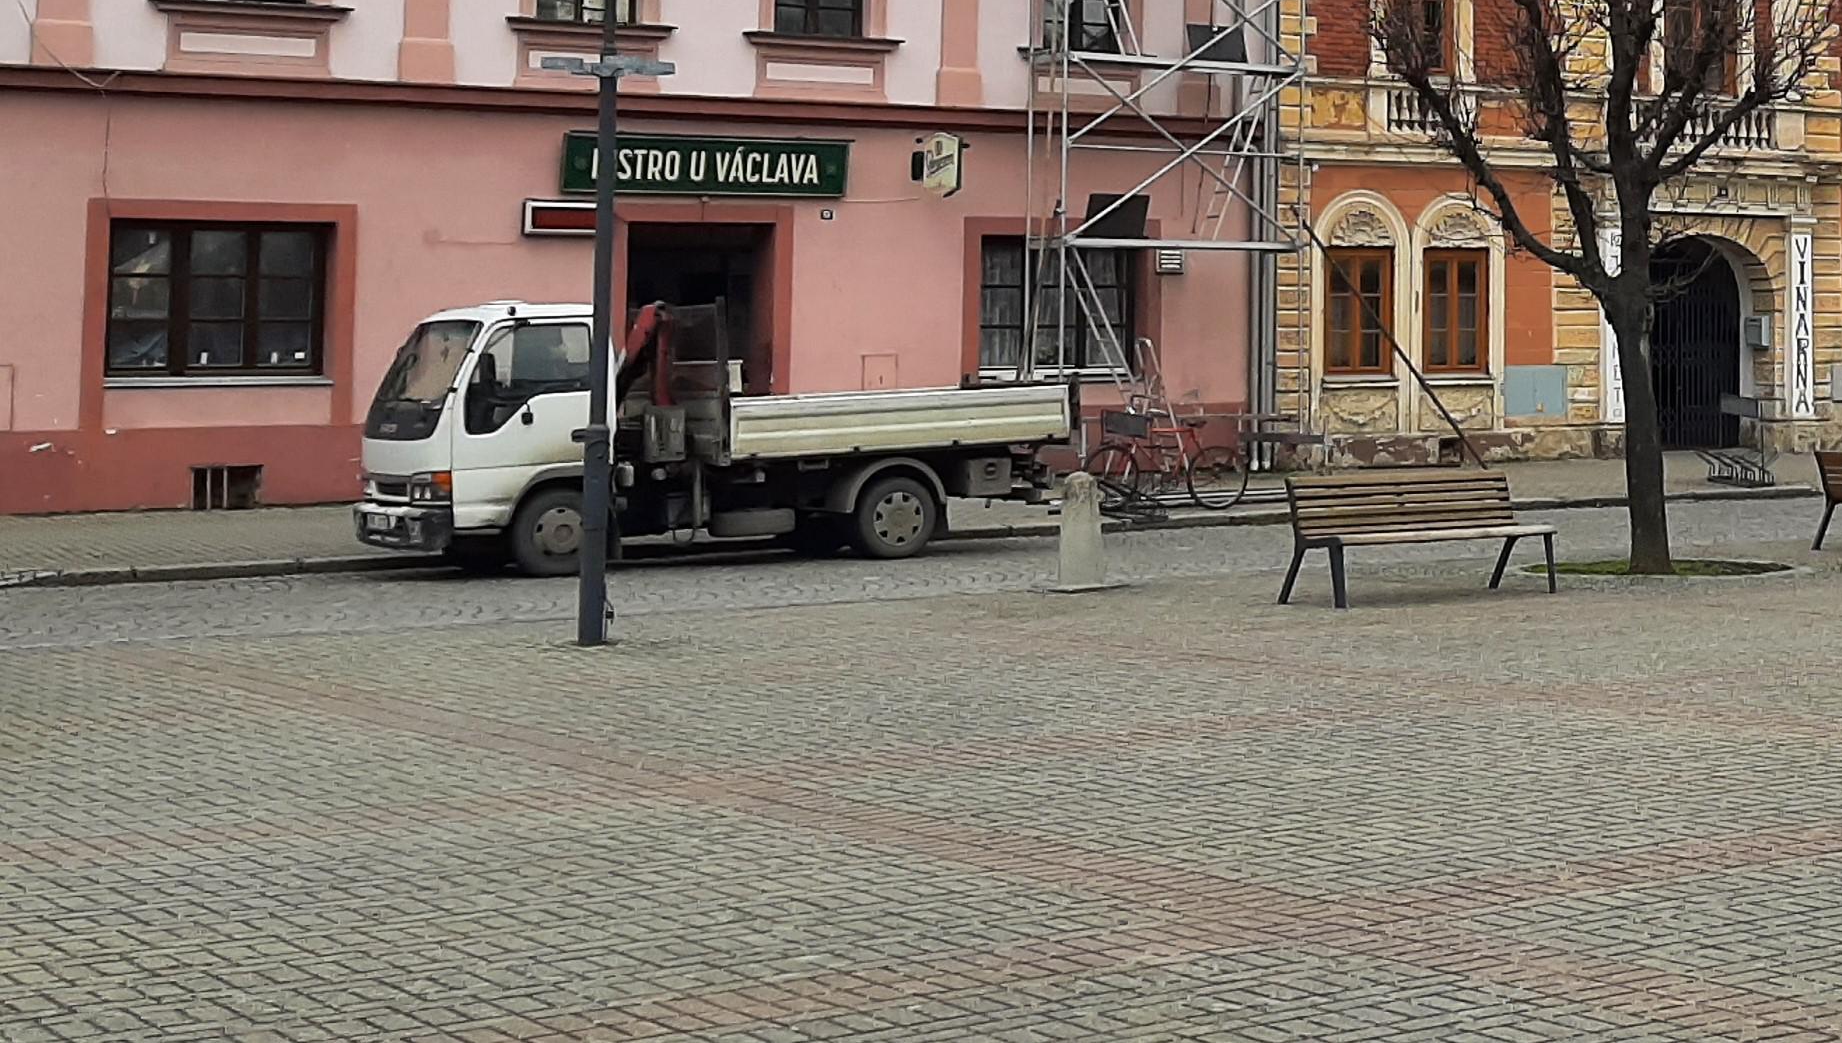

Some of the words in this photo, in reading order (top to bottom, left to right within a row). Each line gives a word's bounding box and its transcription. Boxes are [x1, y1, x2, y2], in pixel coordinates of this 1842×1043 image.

[591, 147, 681, 181] STRO
[690, 151, 706, 182] U
[716, 146, 819, 185] VÁCLAVA
